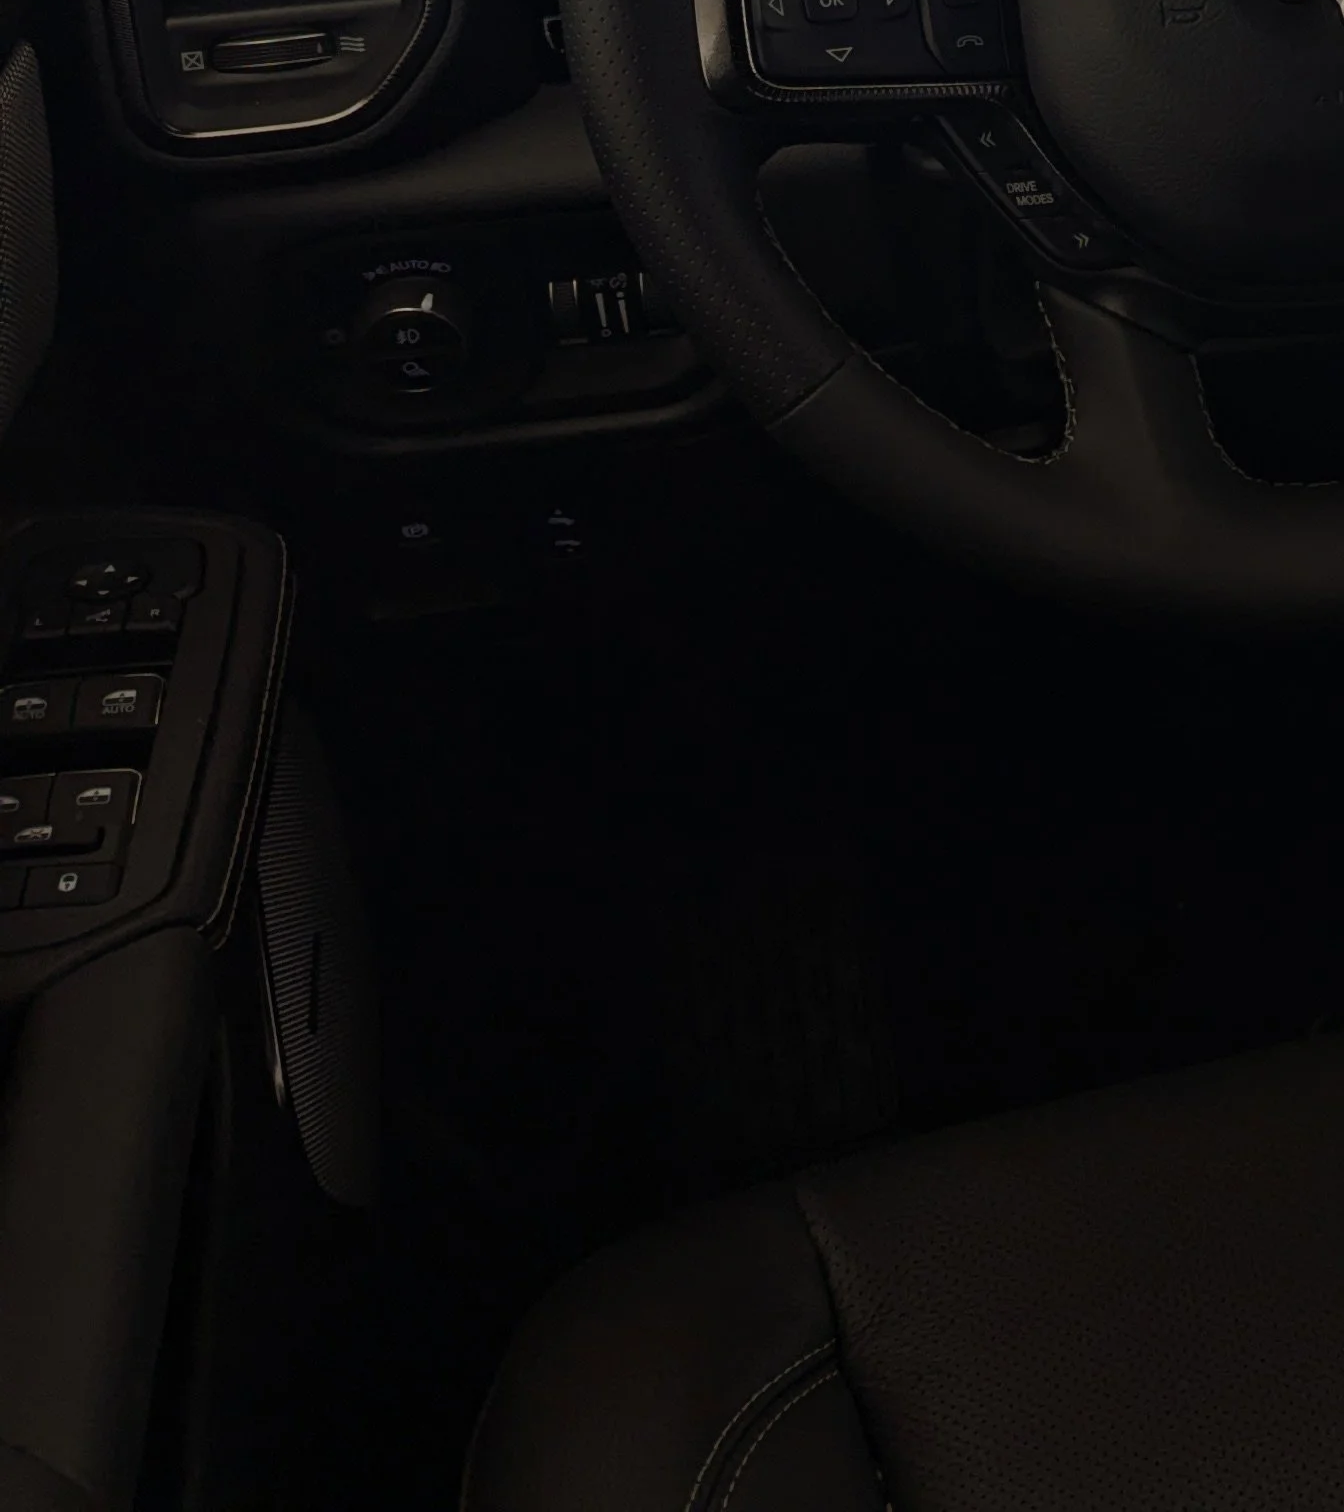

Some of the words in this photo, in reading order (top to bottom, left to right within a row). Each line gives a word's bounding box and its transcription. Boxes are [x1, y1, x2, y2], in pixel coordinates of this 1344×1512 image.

[1006, 180, 1037, 195] DRIVE
[1016, 192, 1055, 207] MODES
[389, 259, 430, 273] AUTO
[102, 704, 135, 715] AUTO
